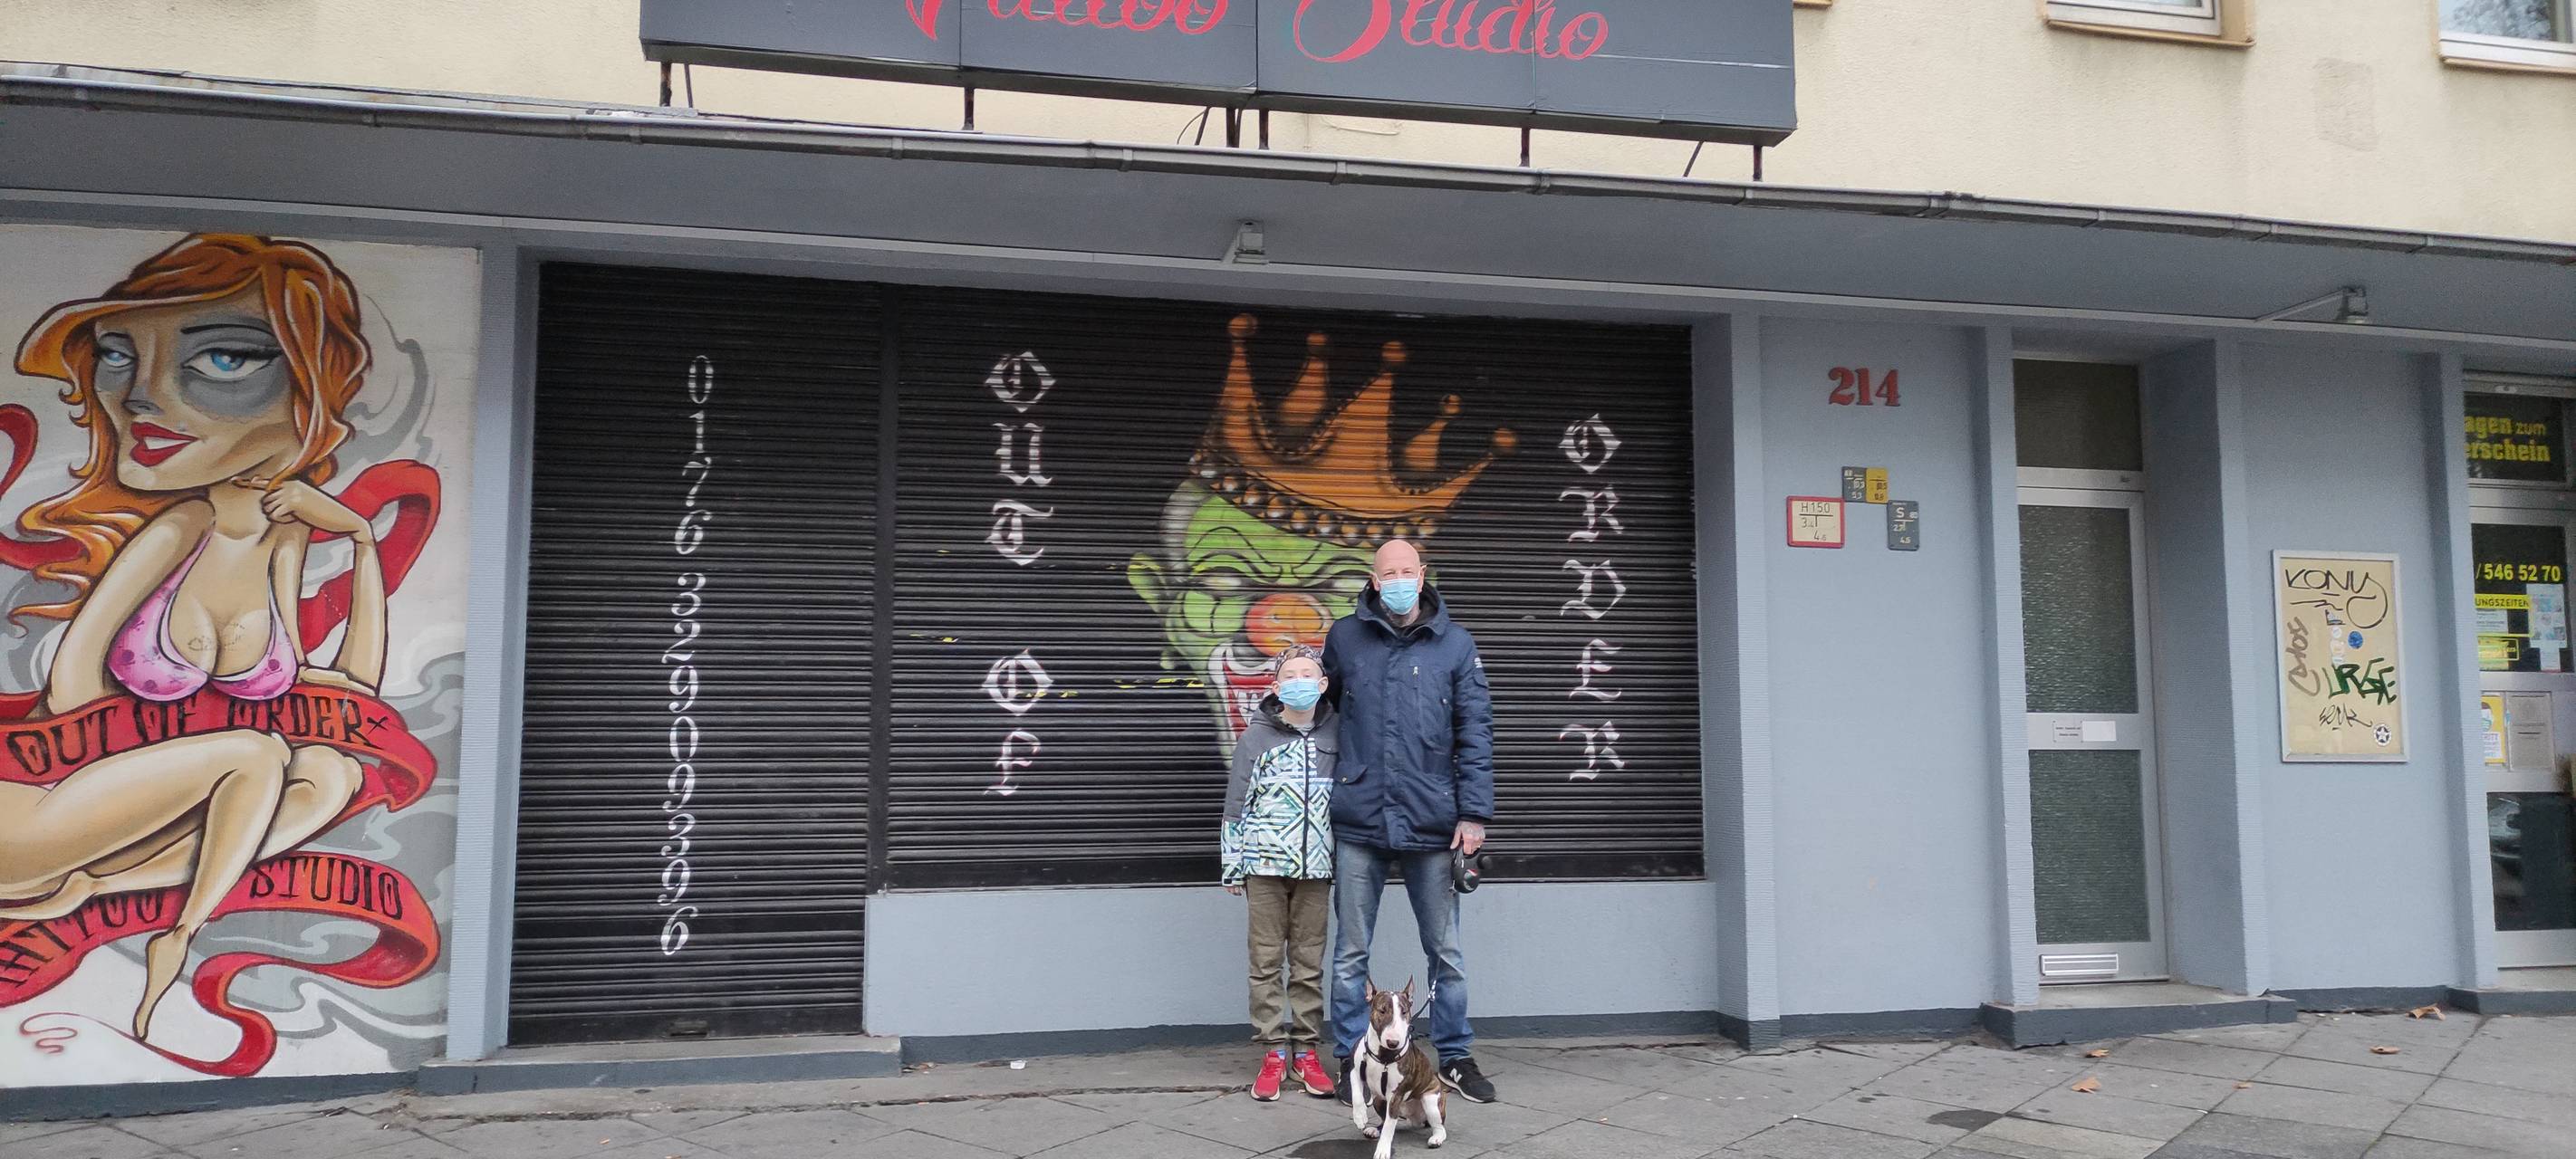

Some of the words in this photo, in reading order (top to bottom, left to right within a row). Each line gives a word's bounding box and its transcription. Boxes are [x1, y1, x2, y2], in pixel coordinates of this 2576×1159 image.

[1828, 366, 1902, 407] 214
[984, 350, 1058, 568] OUT
[1557, 412, 1627, 781] ORDER
[2485, 563, 2514, 580] 546
[2518, 564, 2538, 581] 52
[2541, 565, 2562, 582] 70
[6, 702, 119, 777] OUT
[227, 692, 383, 751] ORDER
[249, 855, 404, 922] STUDIO
